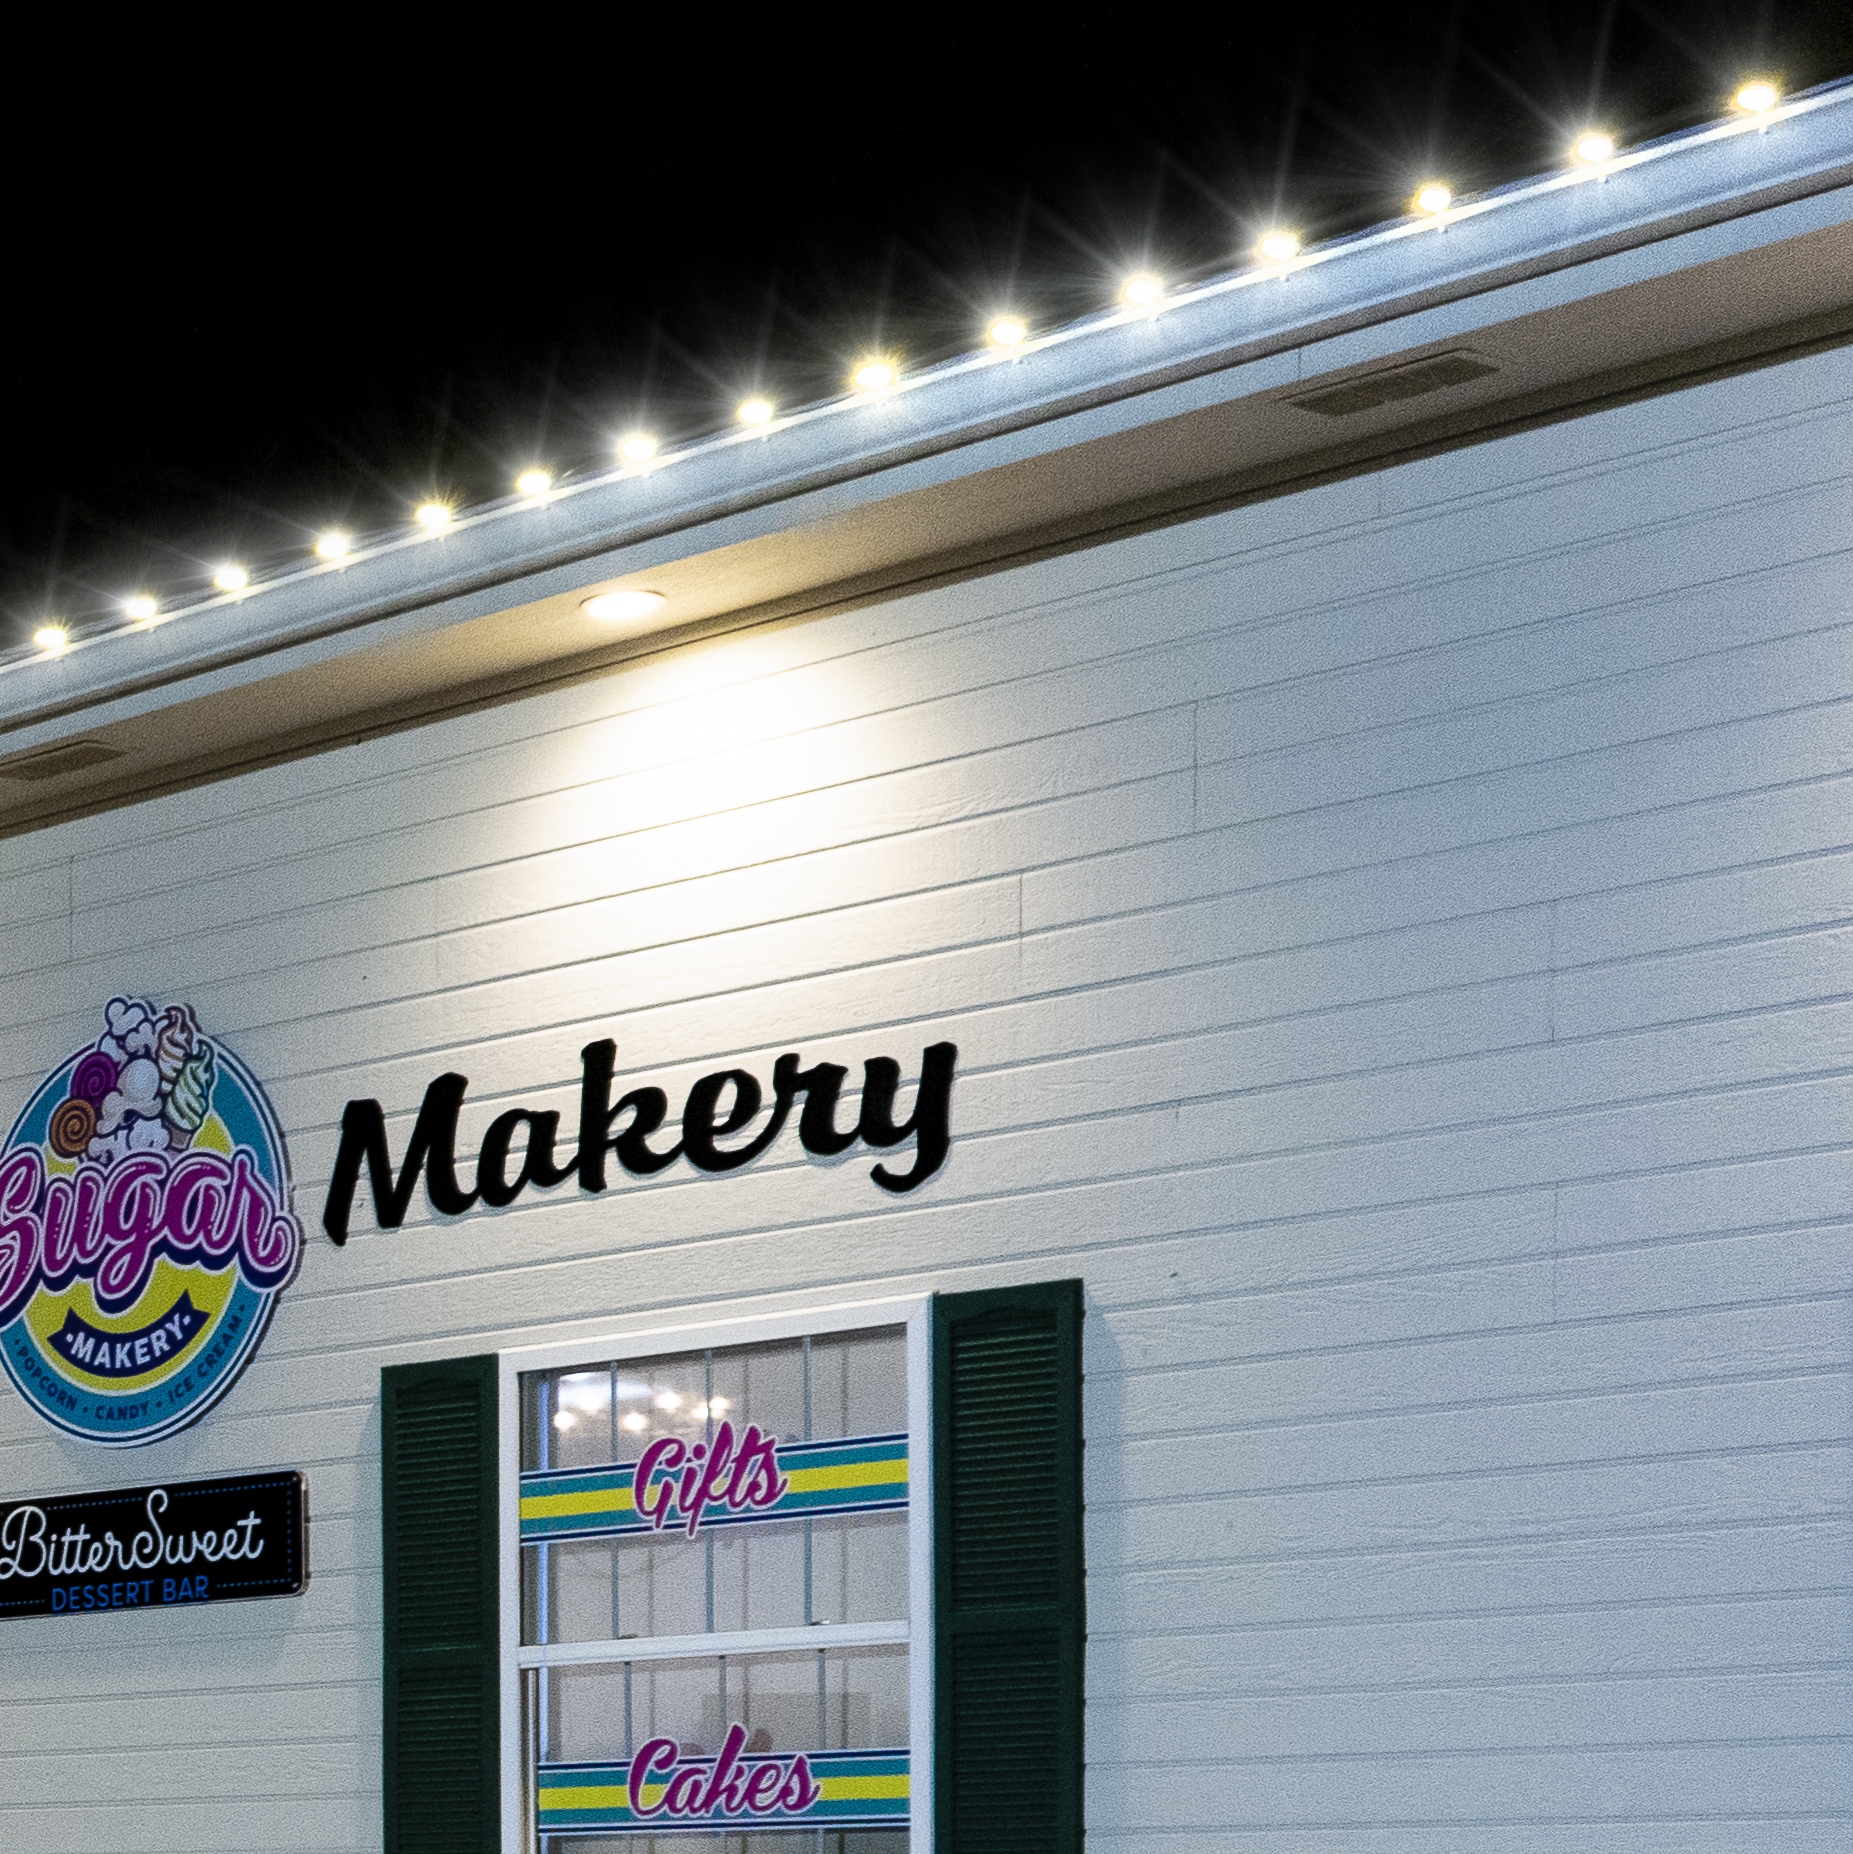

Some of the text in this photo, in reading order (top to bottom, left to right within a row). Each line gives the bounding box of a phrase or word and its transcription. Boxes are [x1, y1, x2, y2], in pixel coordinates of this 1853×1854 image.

[322, 1038, 958, 1245] Makery
[16, 1314, 244, 1422] POPCORN CANDY ICE CREAM
[71, 1313, 185, 1369] MAKERY
[633, 1420, 789, 1538] Gifts
[51, 1575, 210, 1612] DESSERT BAR
[627, 1724, 821, 1819] Cakes
